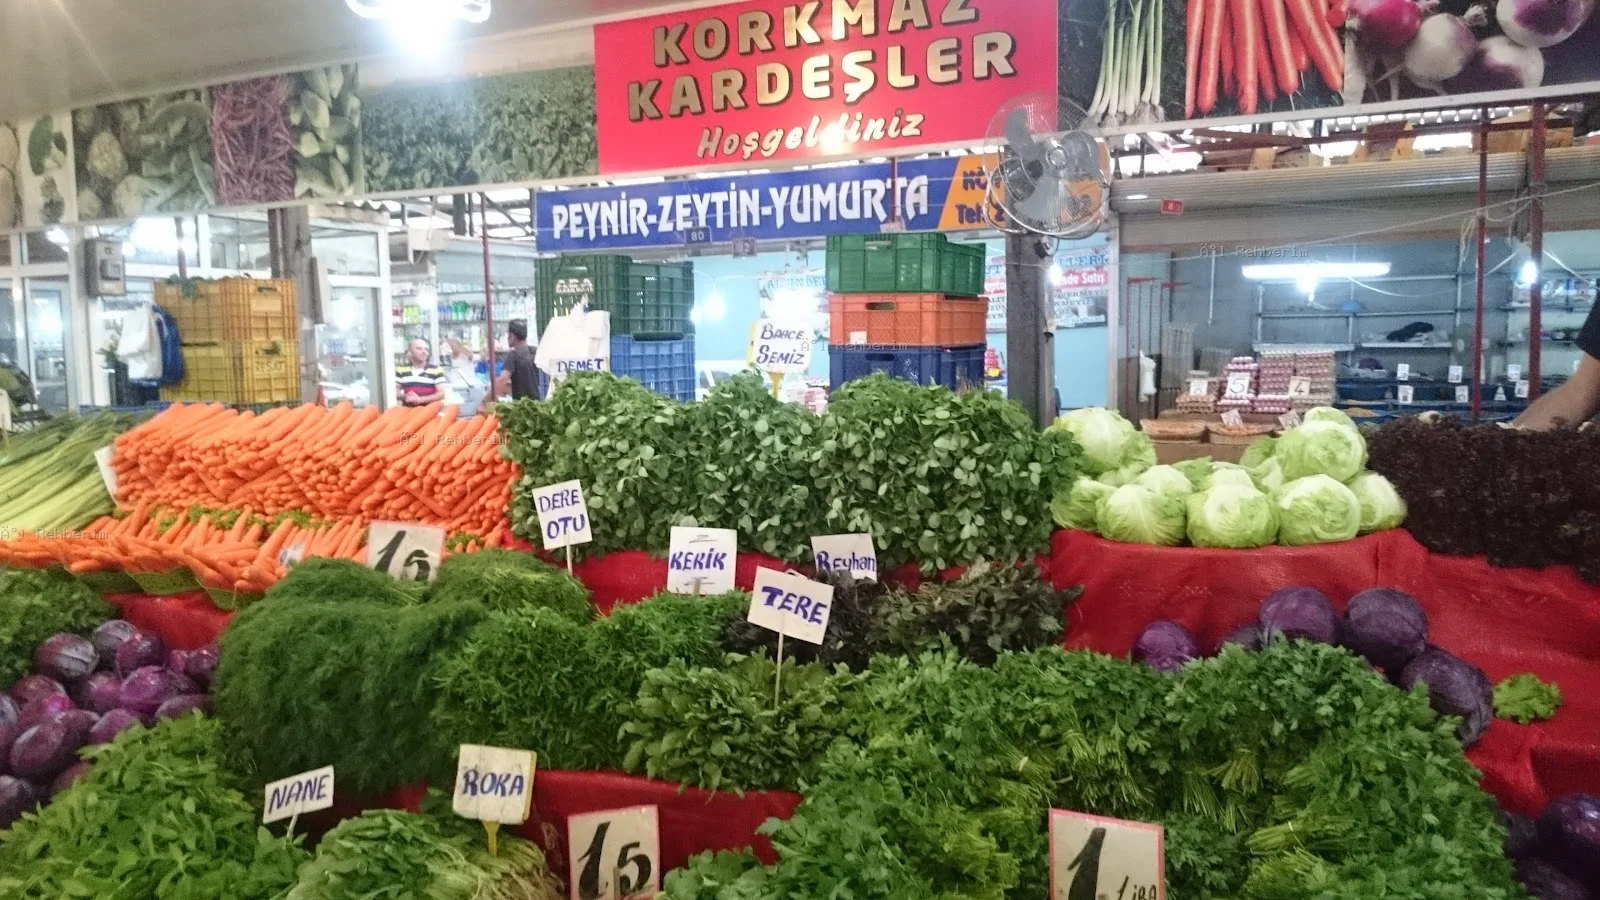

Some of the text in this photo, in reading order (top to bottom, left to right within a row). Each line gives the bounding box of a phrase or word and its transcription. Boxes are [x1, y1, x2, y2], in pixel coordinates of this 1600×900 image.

[653, 0, 979, 67] KORKMAZ
[627, 30, 1017, 121] KARDEŞLER
[690, 231, 705, 242] 80
[557, 358, 604, 372] DEMET
[1229, 377, 1246, 394] 5
[1294, 382, 1306, 395] 4
[539, 489, 580, 512] DERE
[547, 514, 586, 539] OTU
[761, 586, 828, 625] TERE
[268, 774, 330, 814] NANE
[463, 767, 524, 798] ROKA
